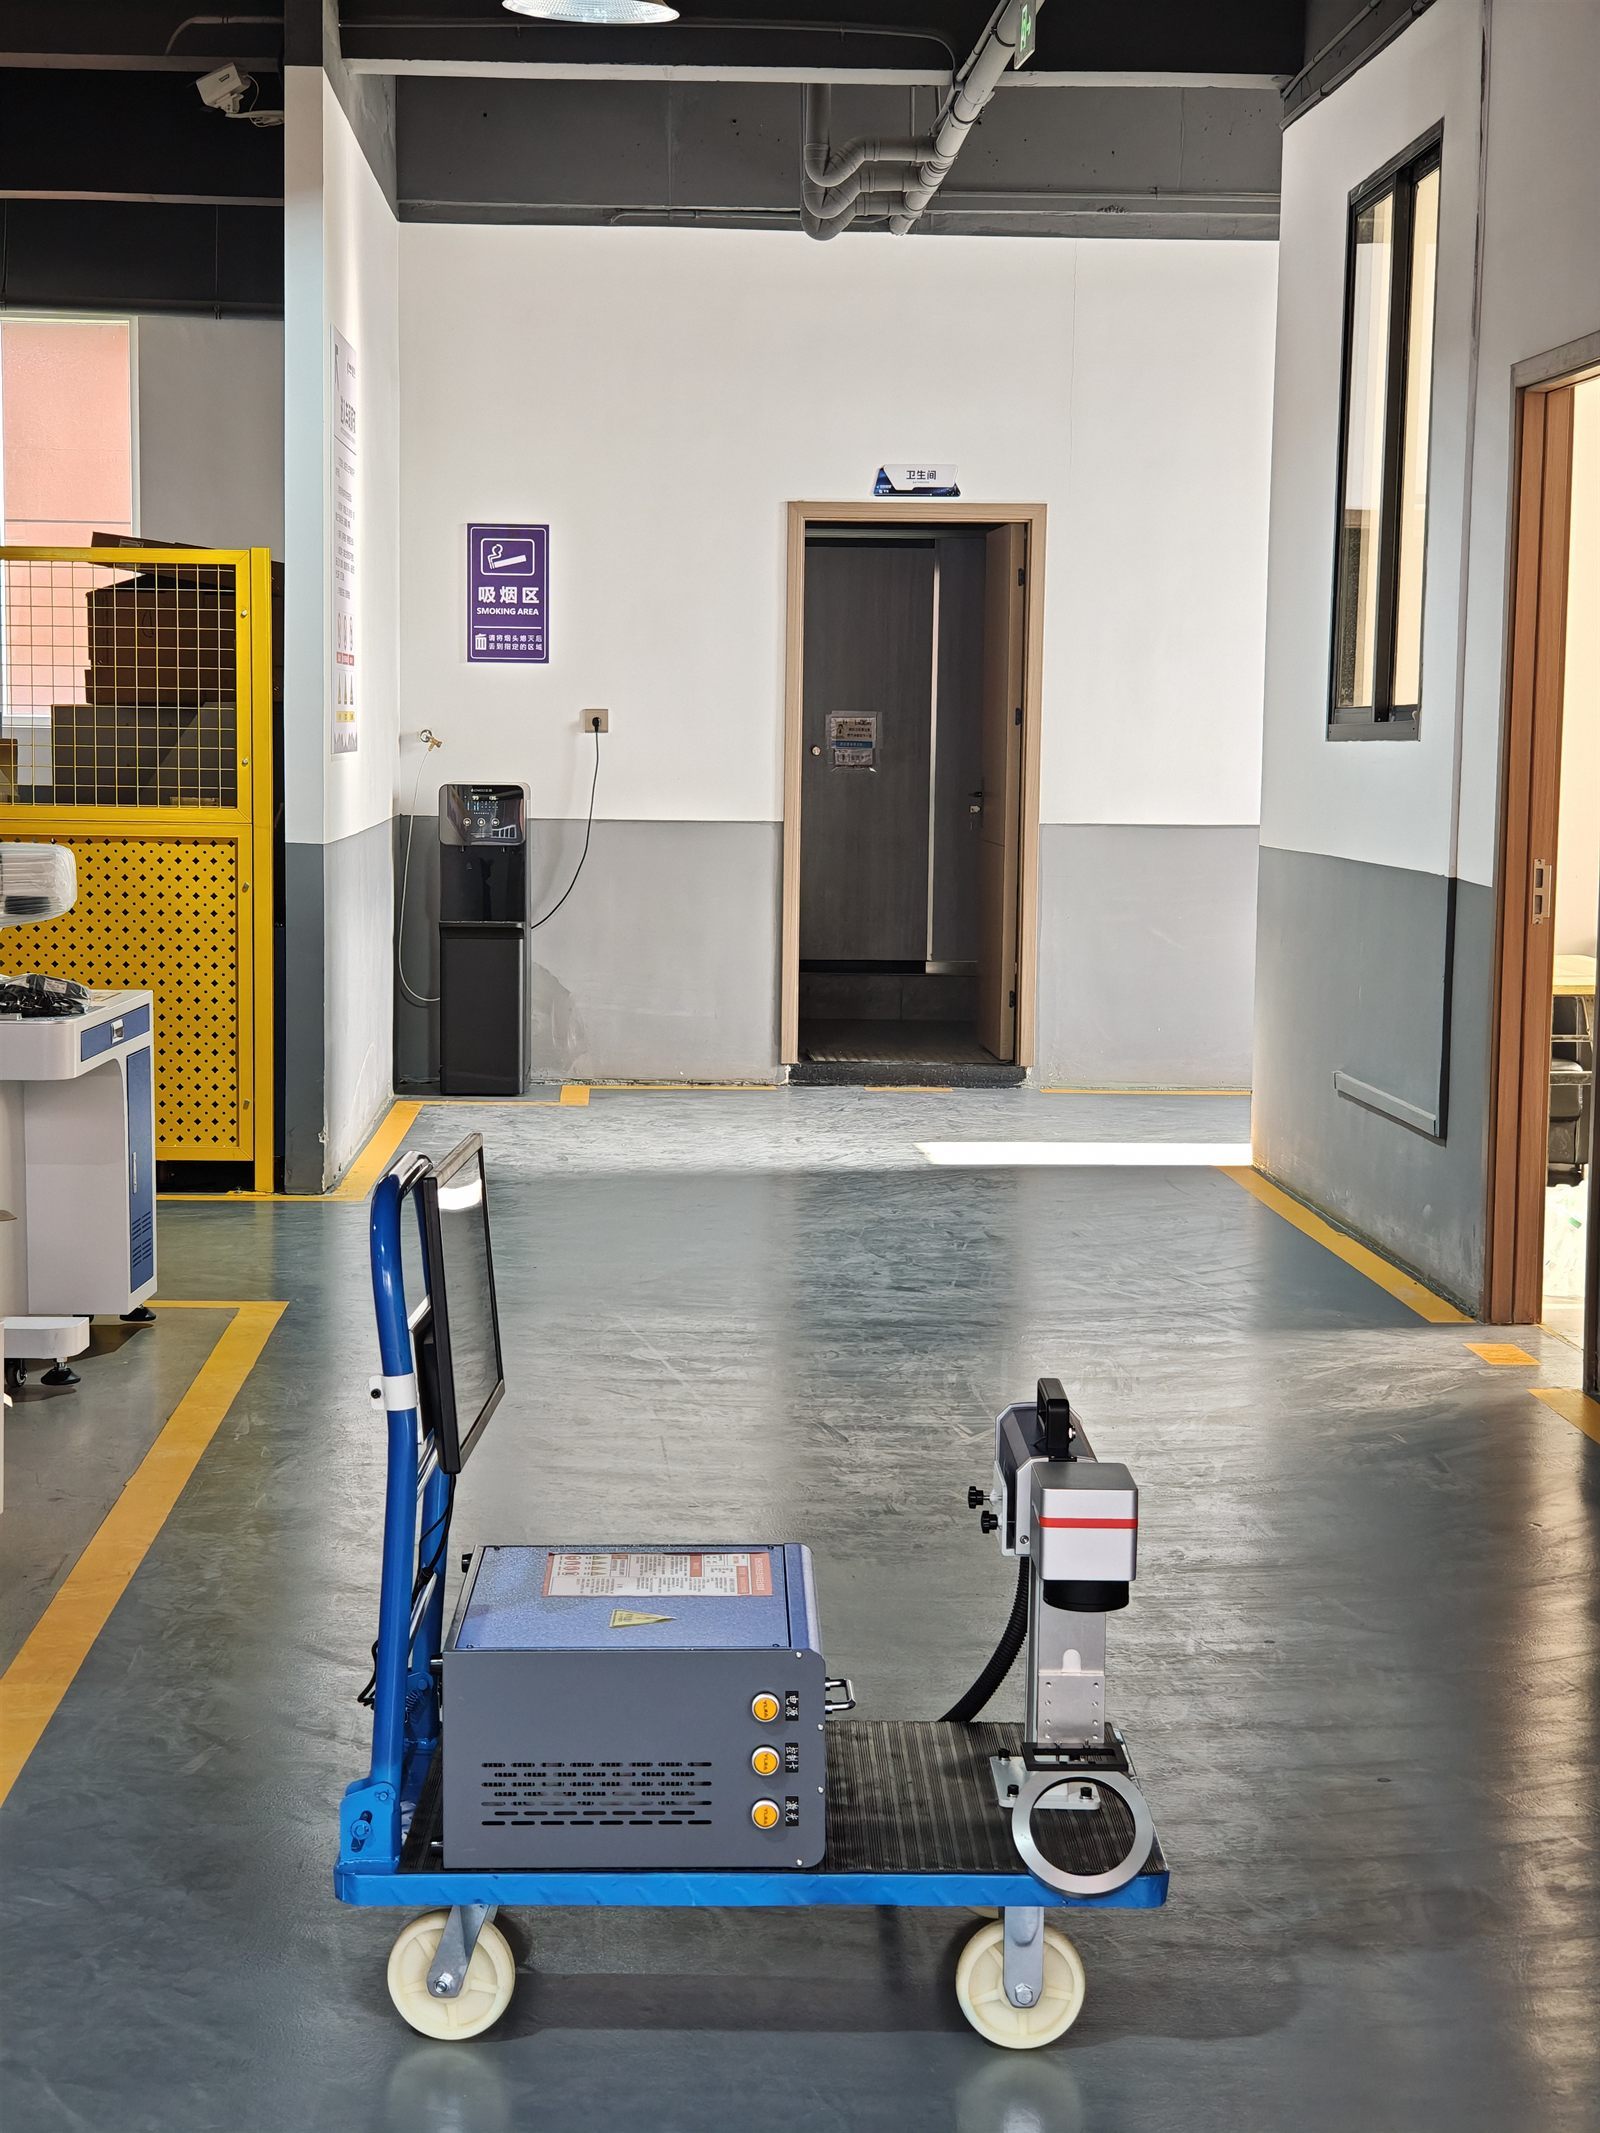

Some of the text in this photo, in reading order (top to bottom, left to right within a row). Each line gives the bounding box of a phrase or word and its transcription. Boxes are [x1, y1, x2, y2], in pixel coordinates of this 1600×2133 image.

[906, 470, 936, 480] 卫生间
[478, 586, 540, 604] 吸烟区
[476, 607, 539, 616] SMOKING AREA
[786, 1695, 799, 1717] 电源
[786, 1746, 799, 1769] 控制卡
[786, 1800, 799, 1822] 激光
